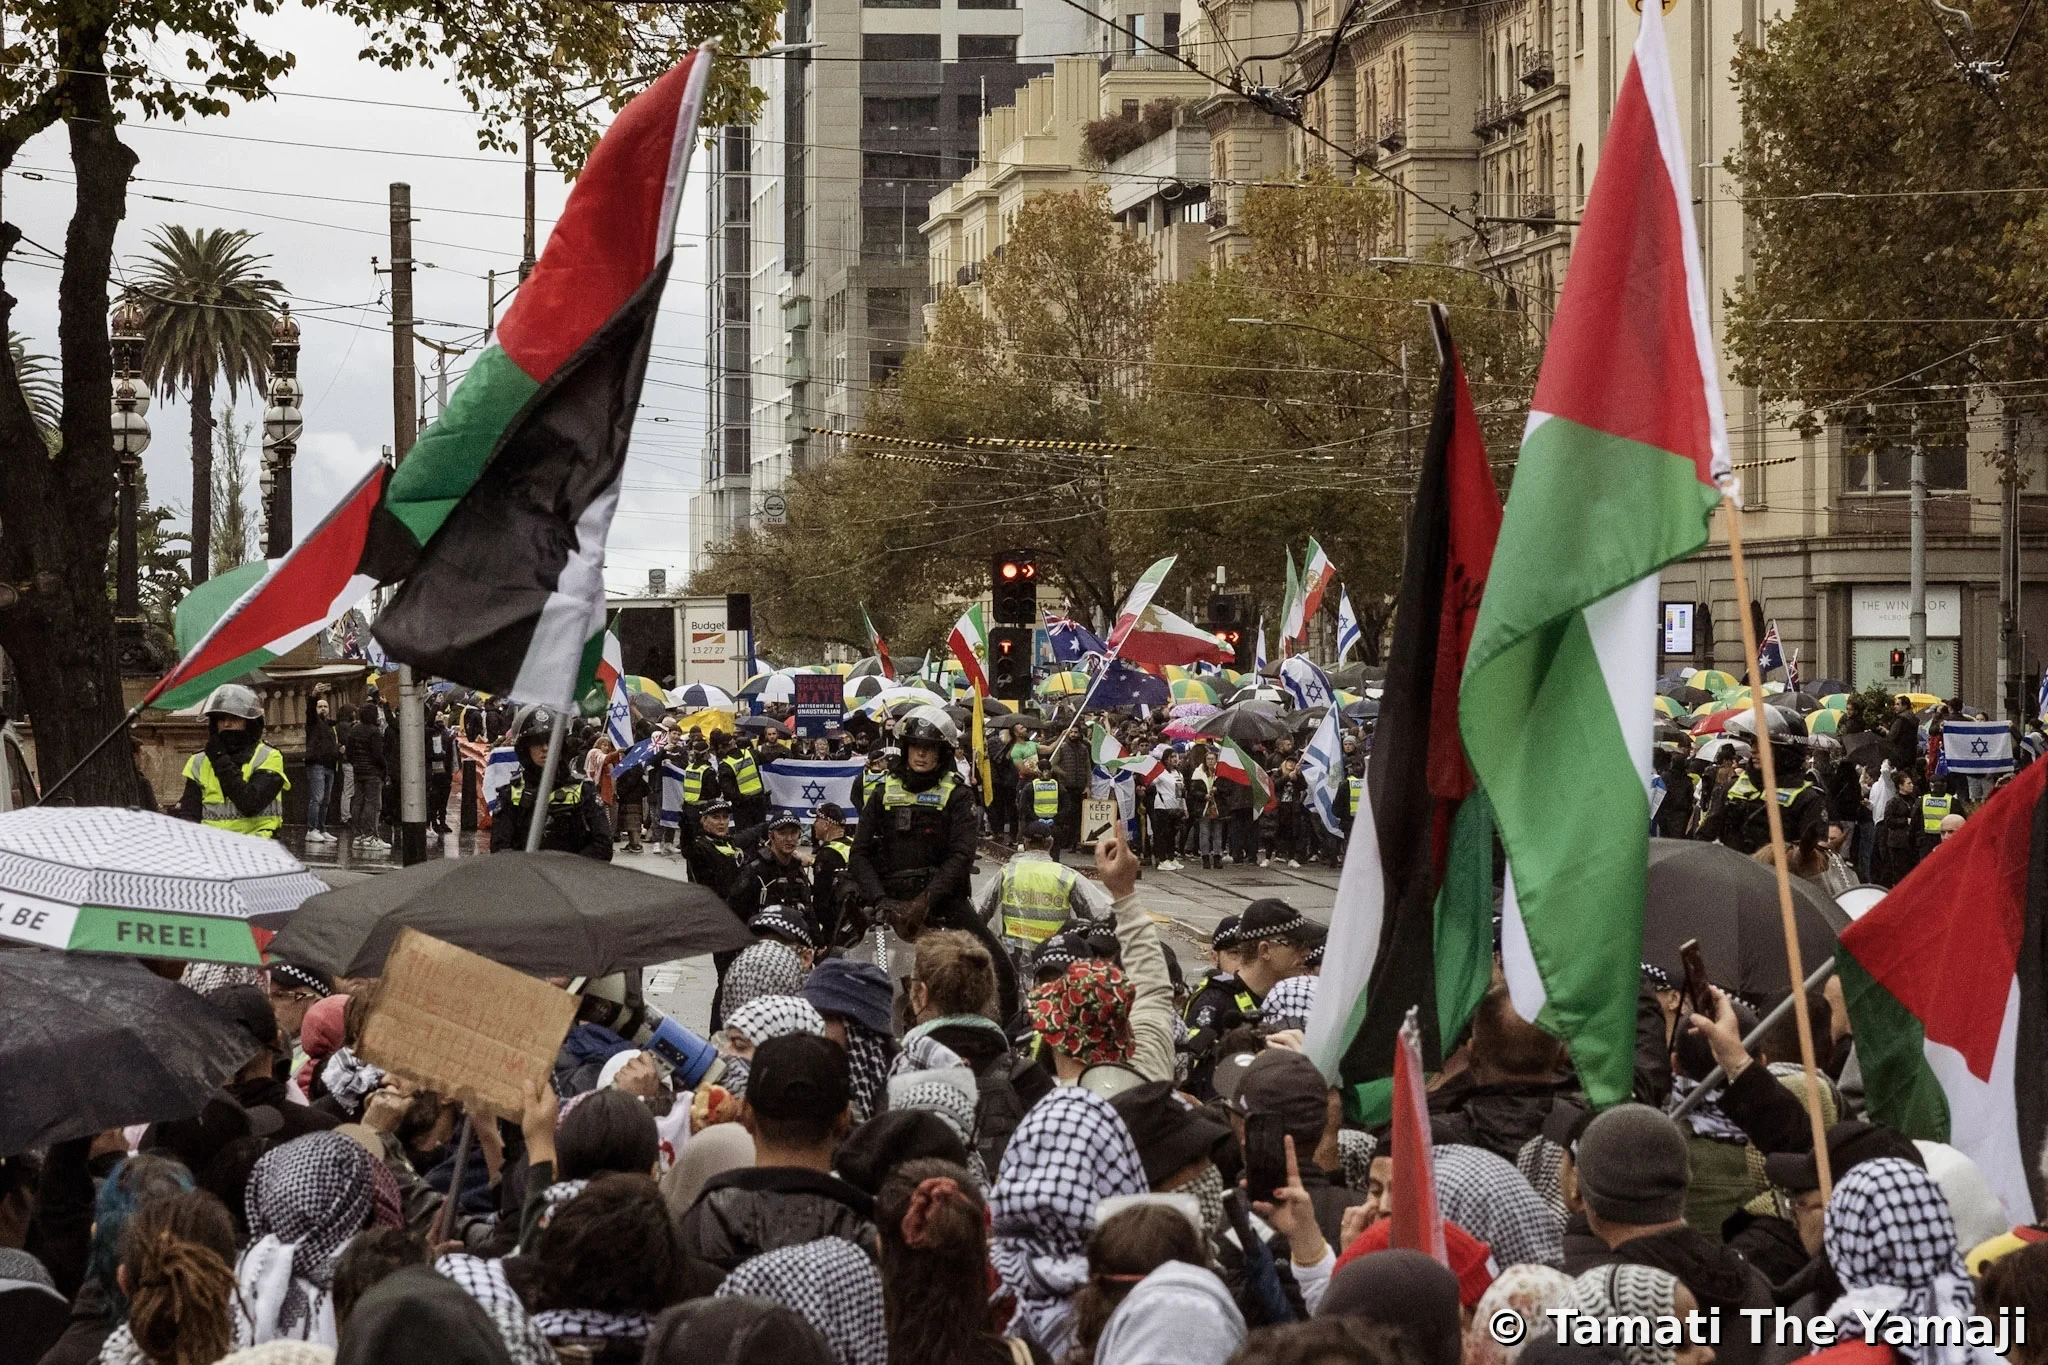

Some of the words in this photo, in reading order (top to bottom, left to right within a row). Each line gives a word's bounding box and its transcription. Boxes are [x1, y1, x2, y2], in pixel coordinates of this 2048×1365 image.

[1862, 600, 1880, 610] THE
[1885, 600, 1947, 610] WINOR
[691, 621, 726, 632] Budget
[1926, 799, 1946, 807] Police
[11, 907, 49, 930] BE
[117, 921, 206, 948] FREE!
